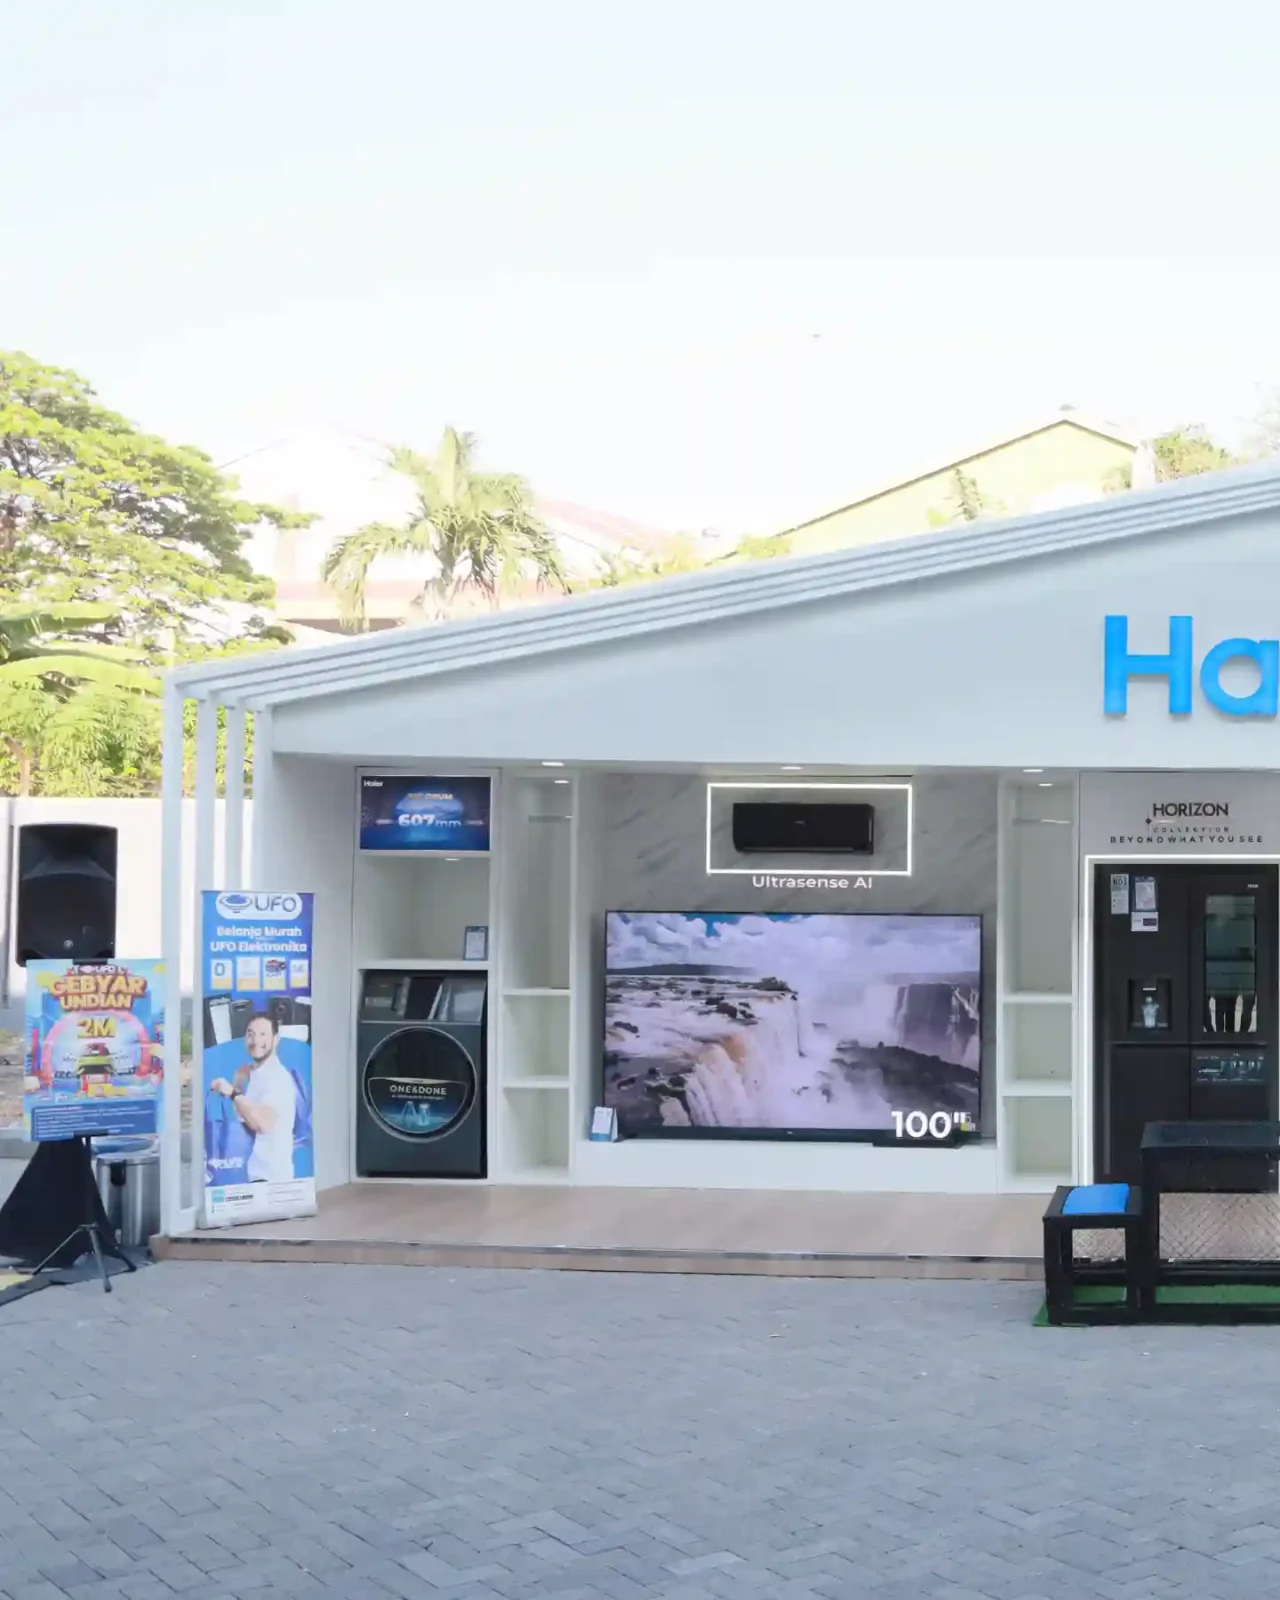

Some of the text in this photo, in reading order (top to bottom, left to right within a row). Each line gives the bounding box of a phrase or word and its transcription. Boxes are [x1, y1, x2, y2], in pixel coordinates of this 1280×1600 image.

[1152, 802, 1230, 817] HORIZON
[398, 813, 436, 827] 607
[1110, 836, 1165, 844] BEYOND
[1167, 836, 1205, 844] WHAT
[752, 875, 873, 889] Ultrasense AI
[254, 895, 297, 913] UFO
[264, 925, 303, 937] Murah
[210, 940, 308, 954] UFO Elektronika
[53, 974, 147, 995] GEBYAR
[61, 993, 132, 1009] UNDIAN
[77, 1018, 116, 1039] 2M
[390, 1085, 447, 1095] ONE&DONE
[891, 1110, 968, 1139] 100"
